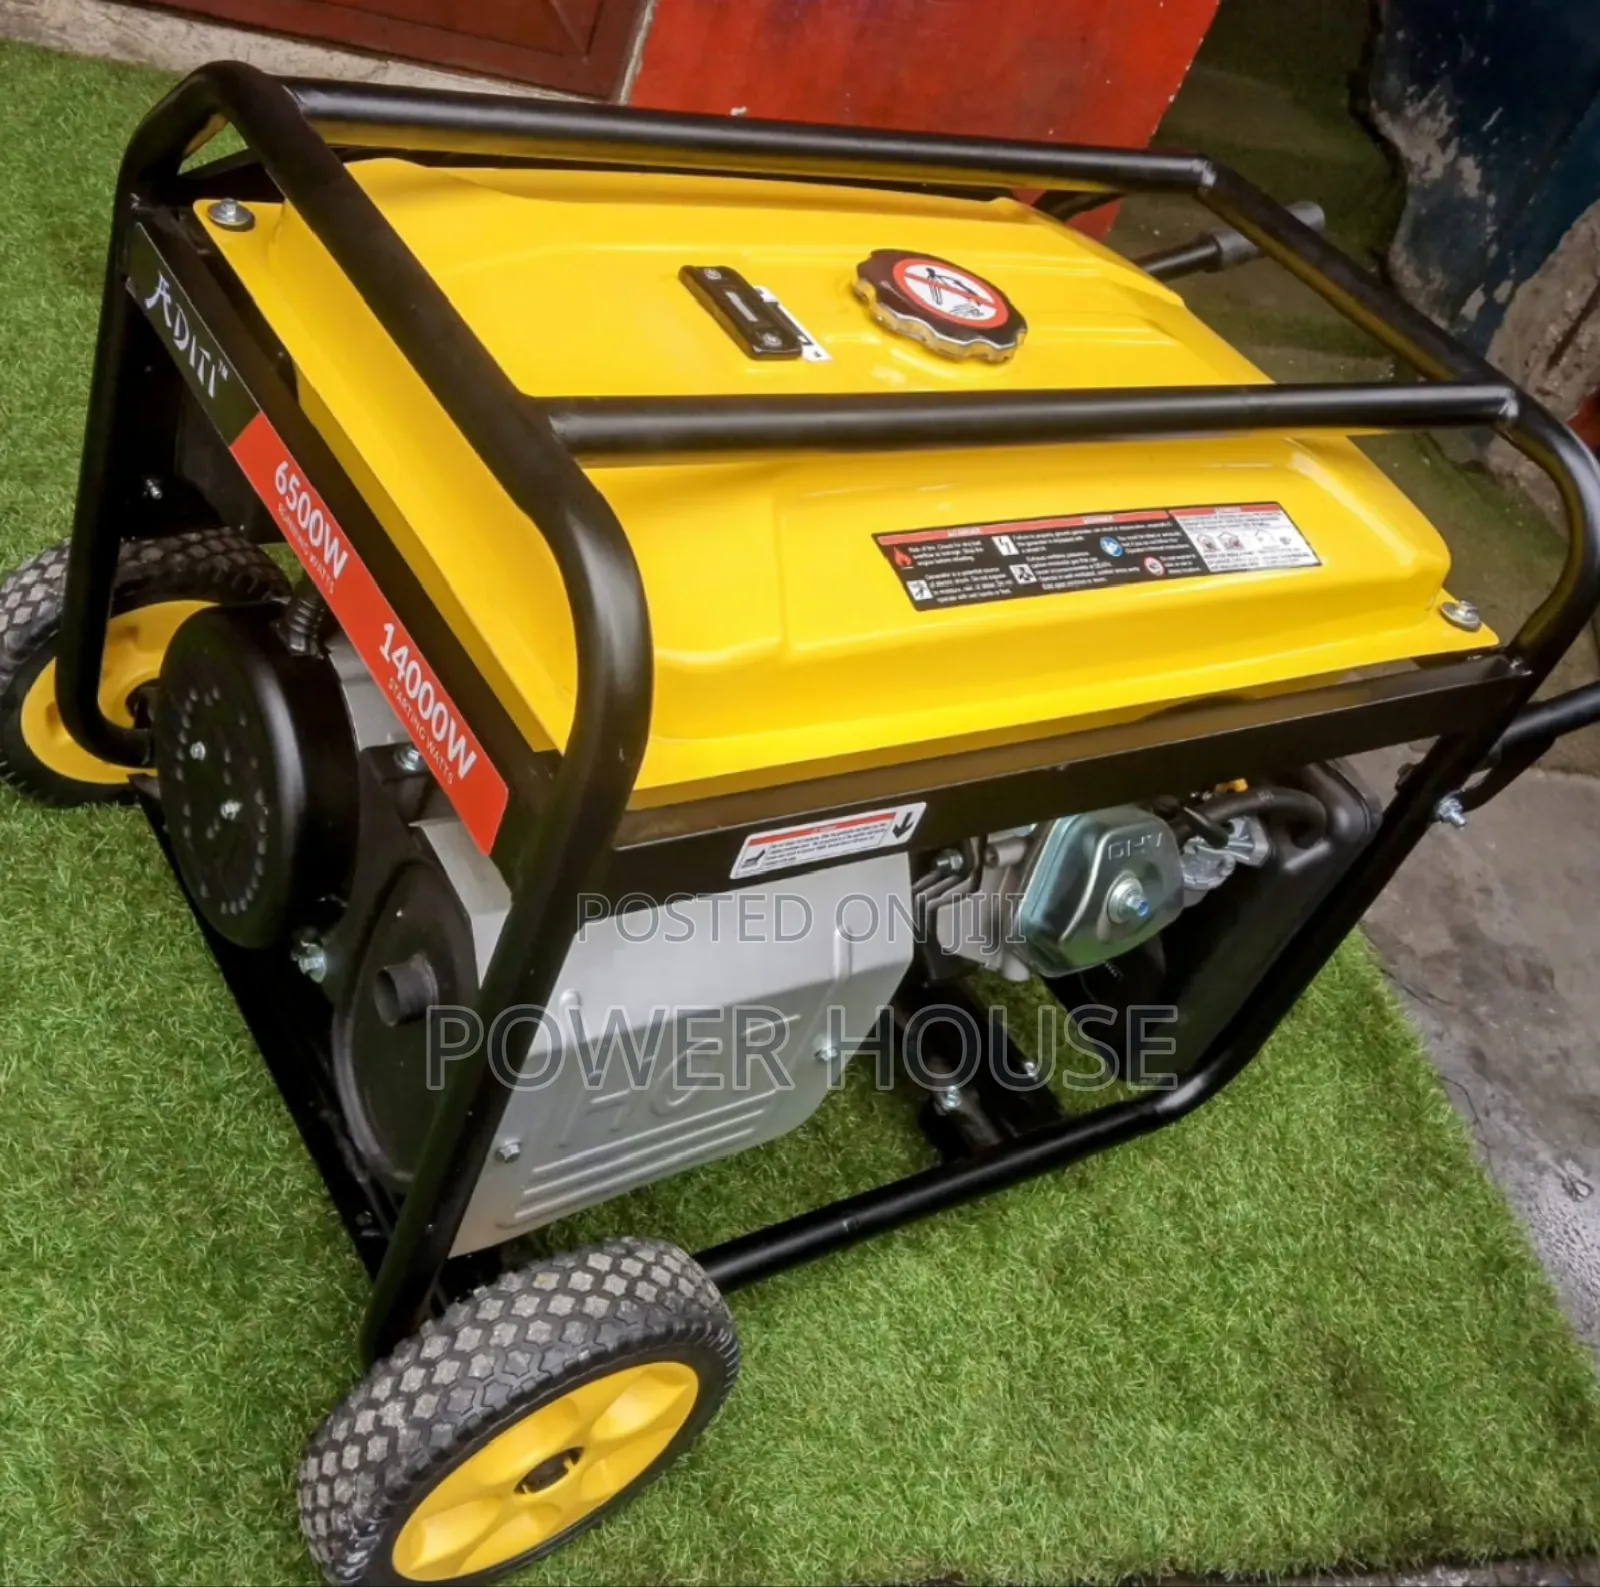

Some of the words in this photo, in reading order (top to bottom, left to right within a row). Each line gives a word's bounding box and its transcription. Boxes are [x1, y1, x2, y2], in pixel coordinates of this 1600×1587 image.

[275, 461, 349, 579] 6500W
[310, 554, 335, 595] WATTS
[379, 622, 477, 781] 14000W
[388, 677, 426, 741] STARTING
[426, 735, 454, 785] WATTS
